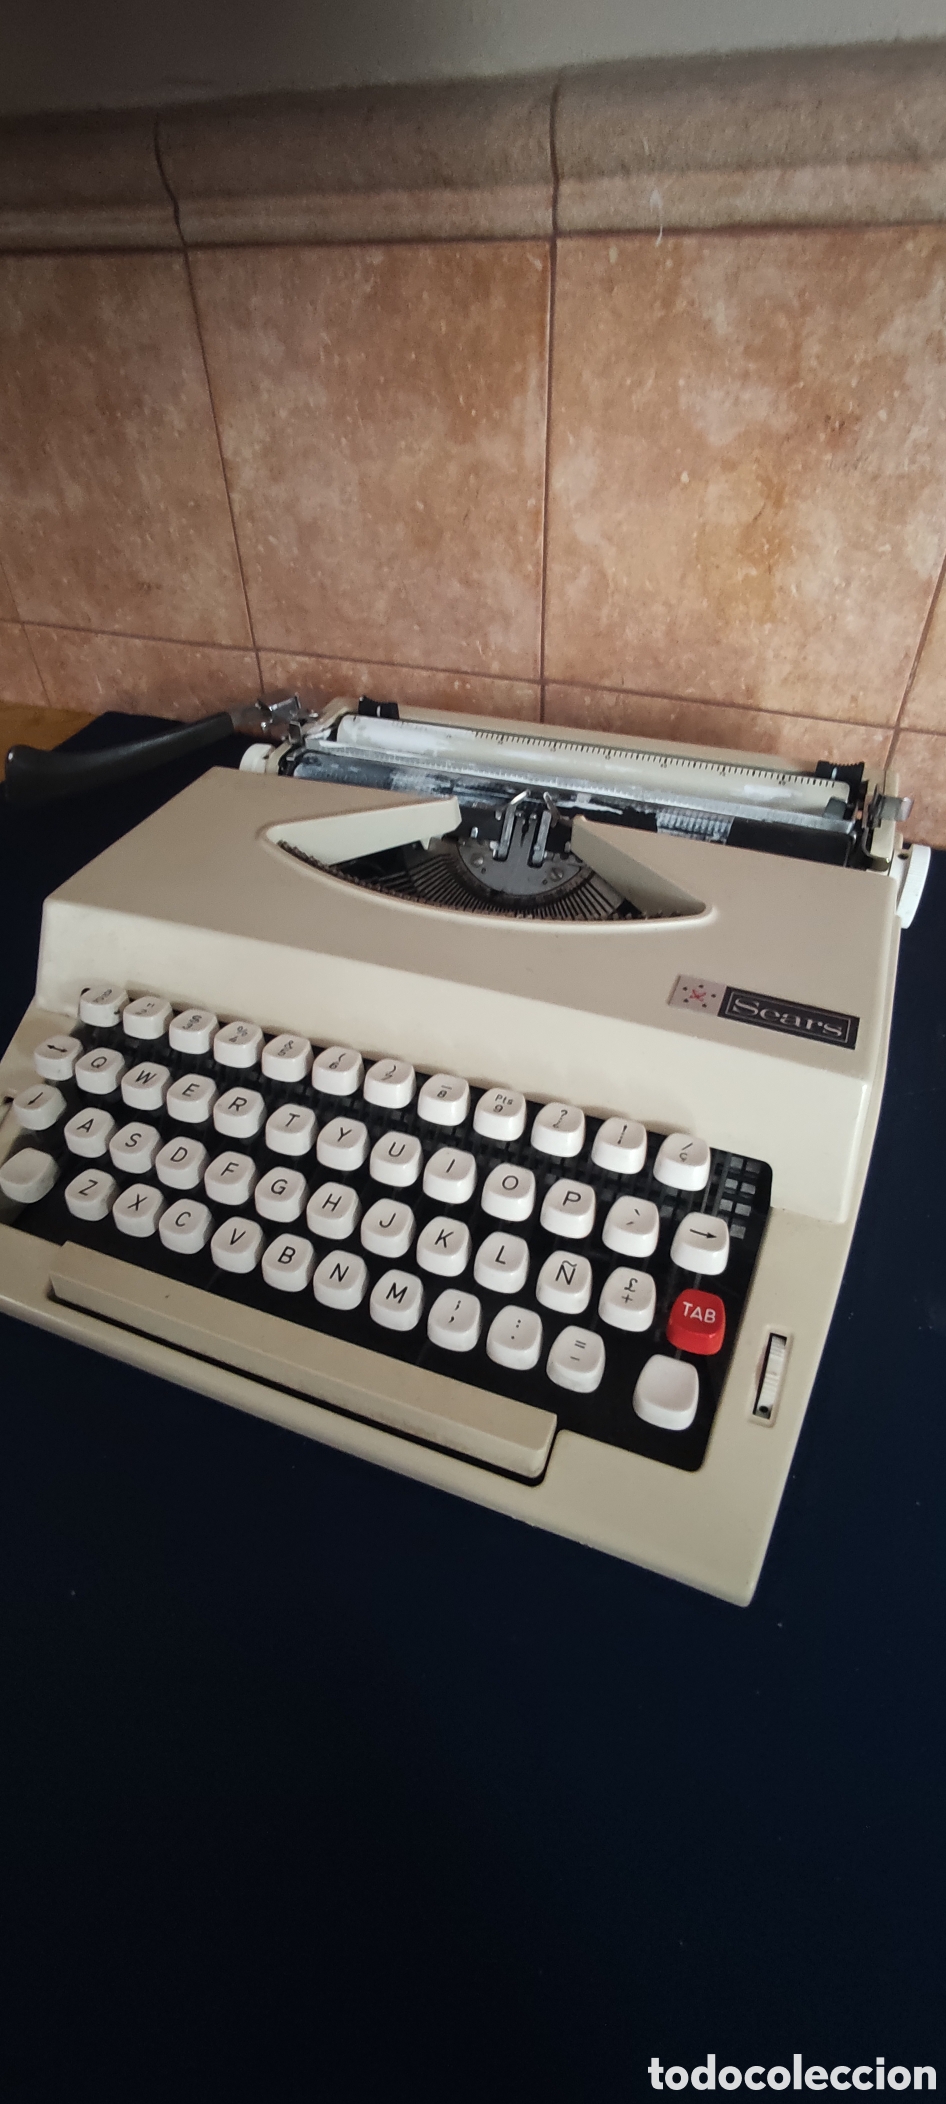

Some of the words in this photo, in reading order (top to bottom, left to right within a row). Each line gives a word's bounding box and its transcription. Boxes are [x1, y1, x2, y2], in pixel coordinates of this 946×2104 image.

[732, 997, 843, 1038] Sears
[91, 1056, 107, 1068] Q
[136, 1070, 156, 1084] W
[182, 1083, 199, 1096] E
[228, 1096, 247, 1111] R
[495, 1094, 514, 1105] Pts
[77, 1118, 93, 1132] A
[286, 1112, 300, 1127] T
[125, 1132, 141, 1147] S
[338, 1127, 351, 1141] Y
[170, 1146, 187, 1162] D
[389, 1141, 405, 1157] U
[221, 1162, 238, 1176] F
[446, 1159, 455, 1173] I
[79, 1179, 97, 1195] Z
[271, 1178, 287, 1195] G
[502, 1175, 518, 1190] O
[128, 1194, 147, 1211] X
[322, 1193, 341, 1211] H
[563, 1190, 581, 1205] P
[175, 1211, 191, 1226] C
[380, 1213, 396, 1228] J
[230, 1228, 245, 1245] V
[435, 1229, 453, 1248] K
[278, 1245, 295, 1264] B
[495, 1245, 505, 1264] L
[330, 1262, 349, 1282] N
[556, 1260, 576, 1285] Ñ
[386, 1282, 407, 1303] M
[682, 1300, 717, 1324] TAB
